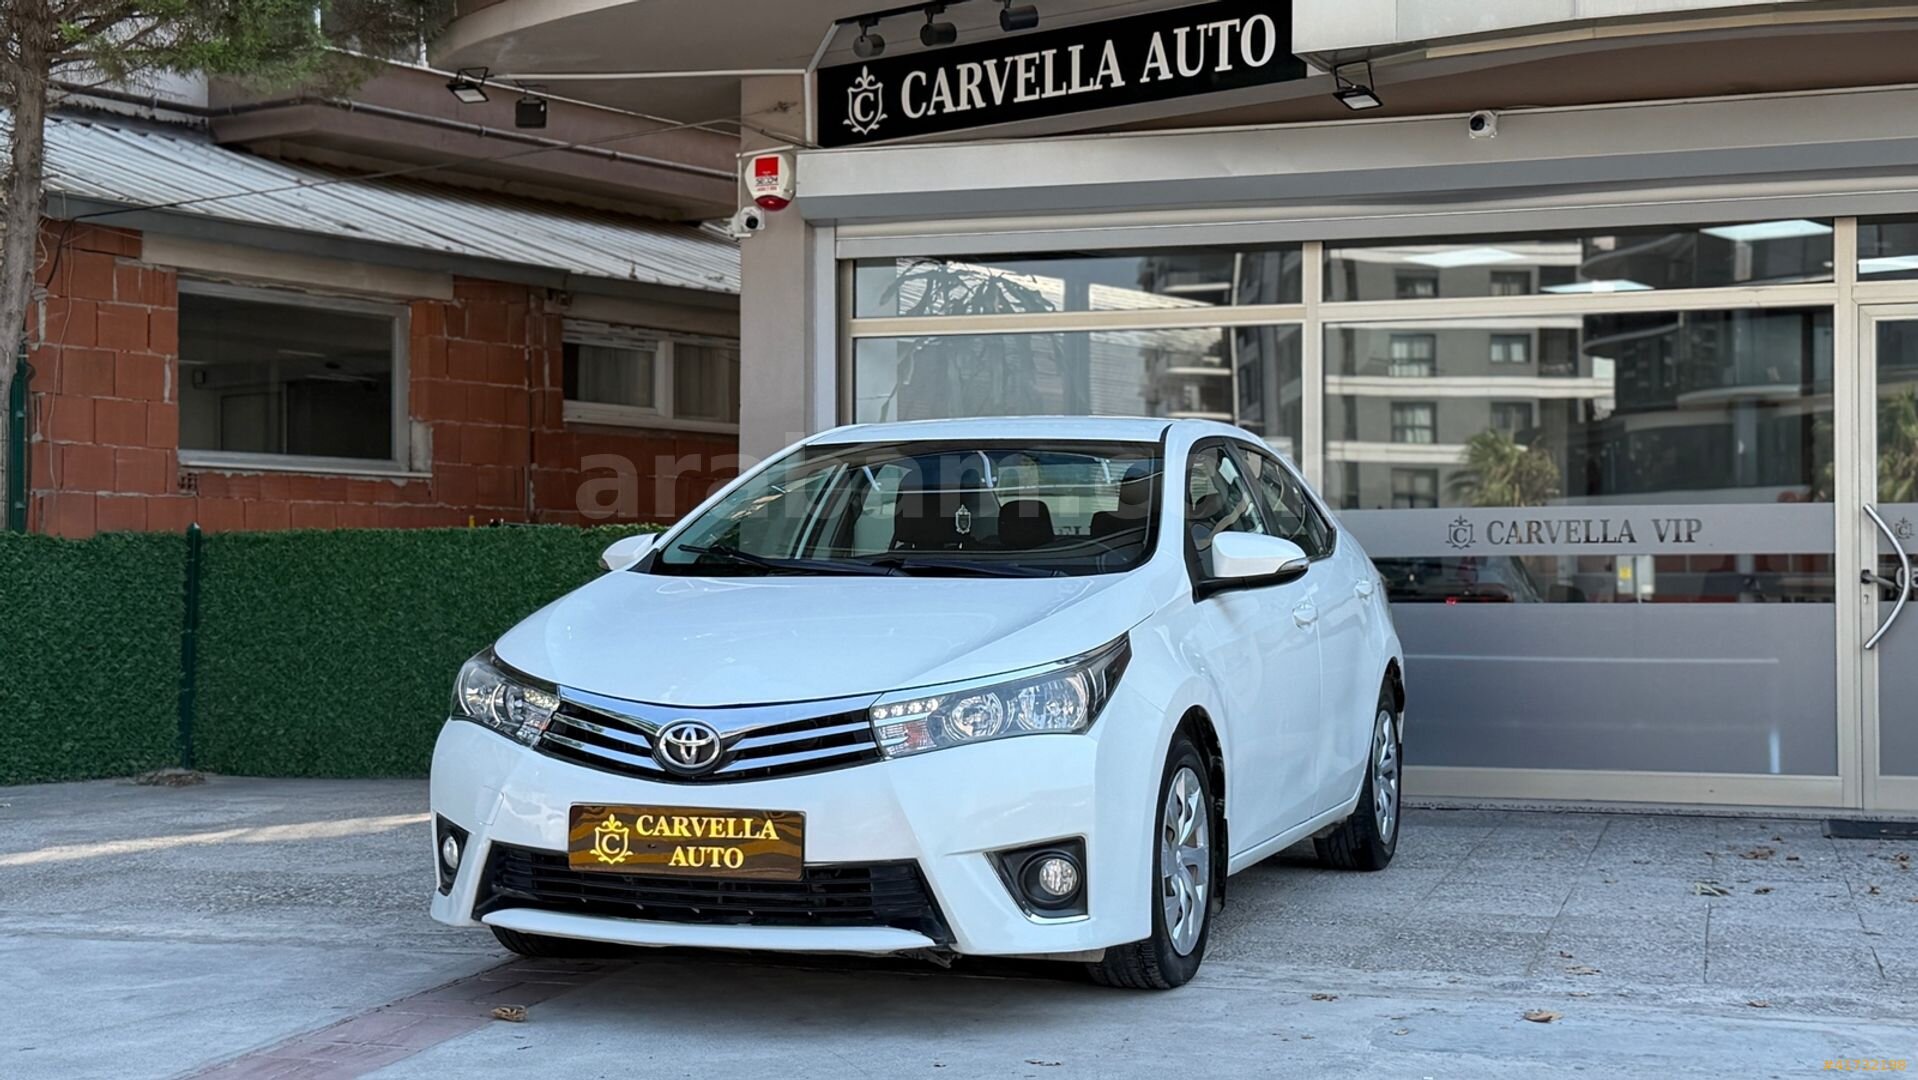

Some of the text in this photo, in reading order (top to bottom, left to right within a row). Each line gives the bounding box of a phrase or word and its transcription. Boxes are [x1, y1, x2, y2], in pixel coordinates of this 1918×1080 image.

[853, 13, 1276, 122] C CARVELLA AUTO
[1452, 518, 1703, 545] C CARVELLA VIP
[635, 814, 781, 840] CARVELLA
[601, 833, 745, 870] C AUTO
